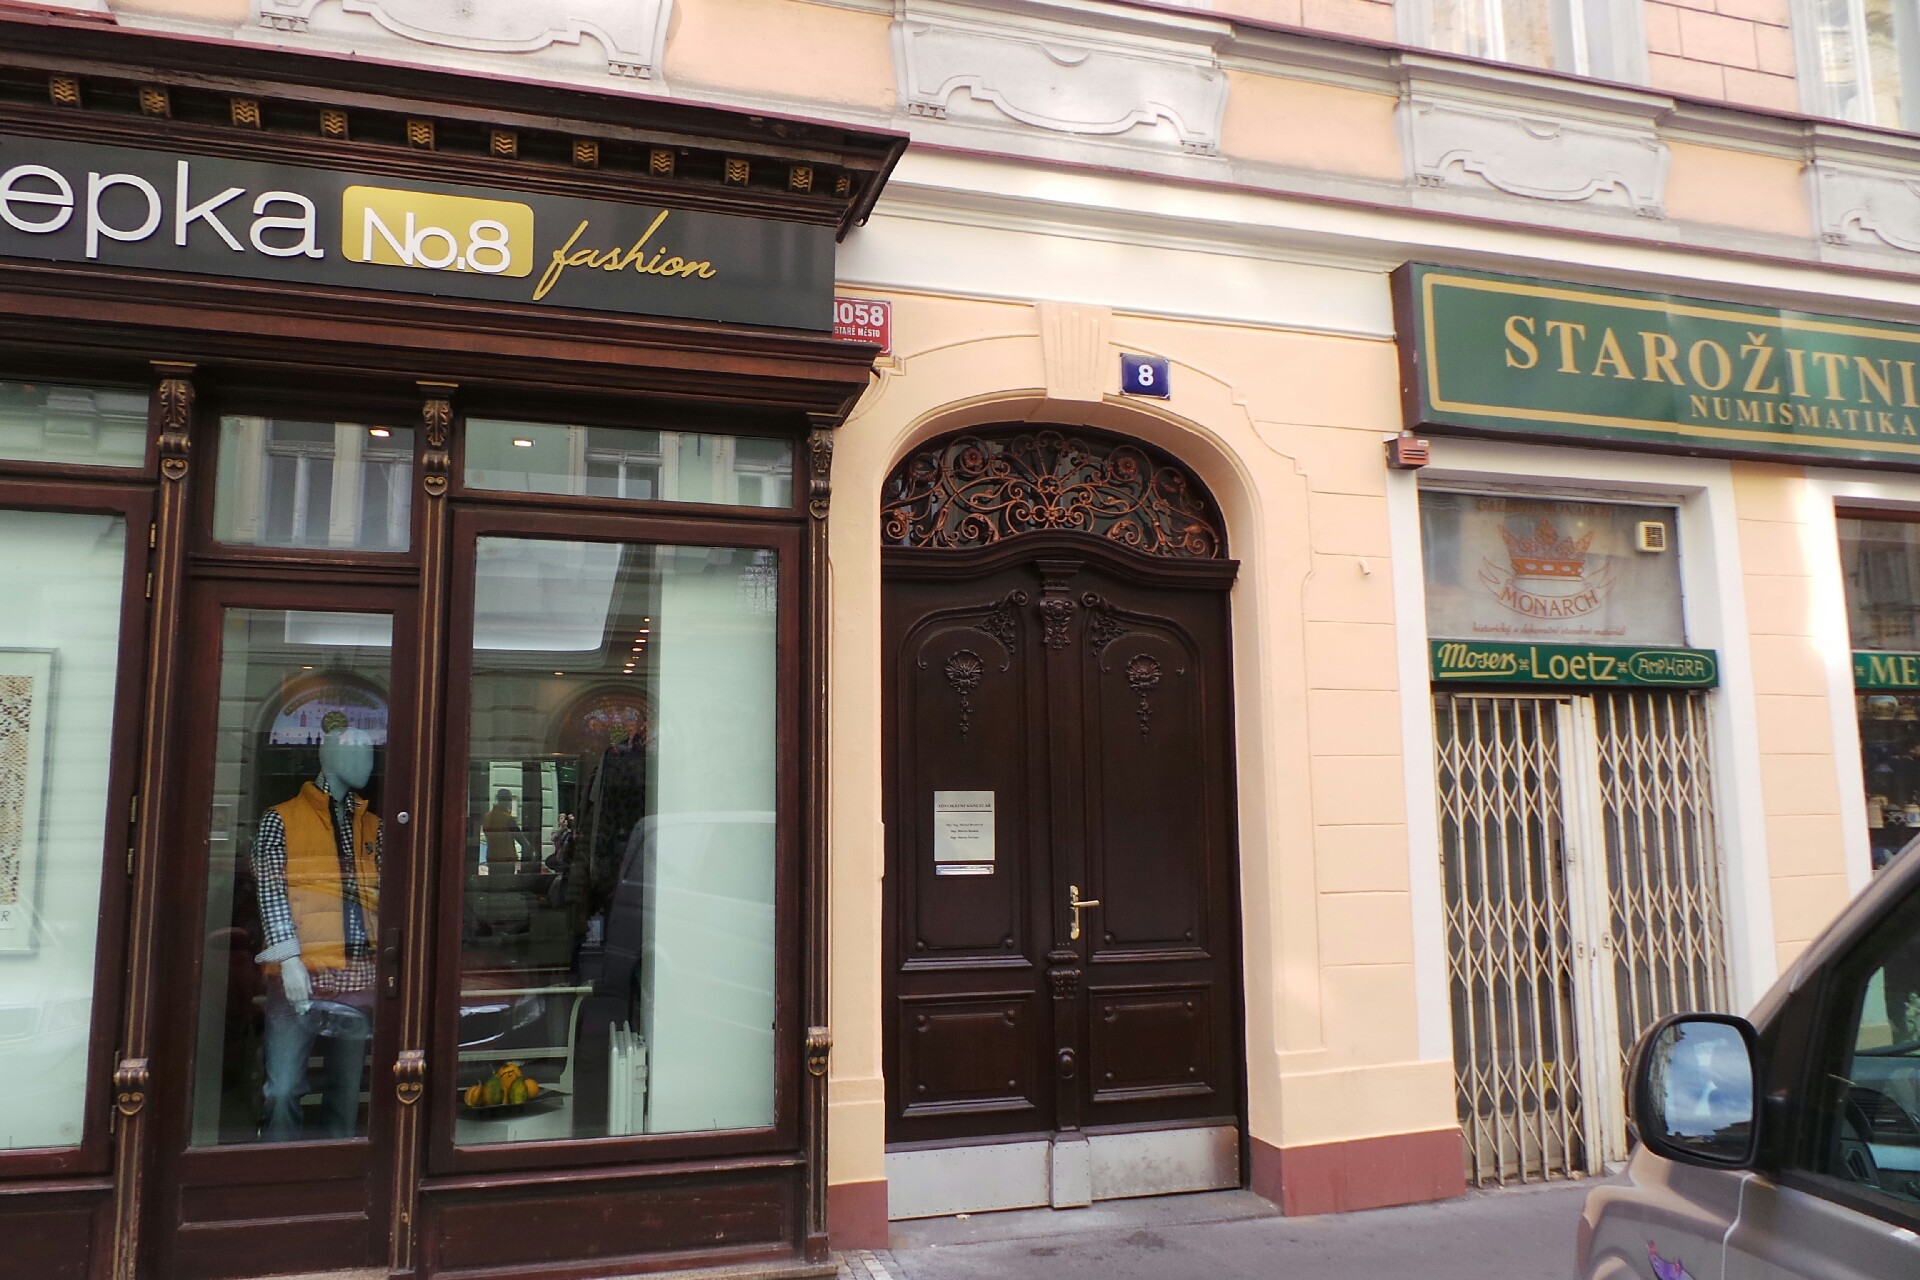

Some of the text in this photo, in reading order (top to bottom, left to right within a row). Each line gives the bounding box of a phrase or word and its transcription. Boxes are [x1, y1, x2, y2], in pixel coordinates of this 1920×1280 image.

[0, 160, 716, 301] epka No.8 fashion
[833, 302, 884, 326] 1058
[1138, 364, 1154, 386] 8
[1503, 314, 1920, 408] STAROŽITNI
[1689, 394, 1918, 436] NUMISMATIKA
[1501, 586, 1599, 617] MONARCH
[1530, 647, 1619, 680] Loetz
[1867, 656, 1920, 686] ME
